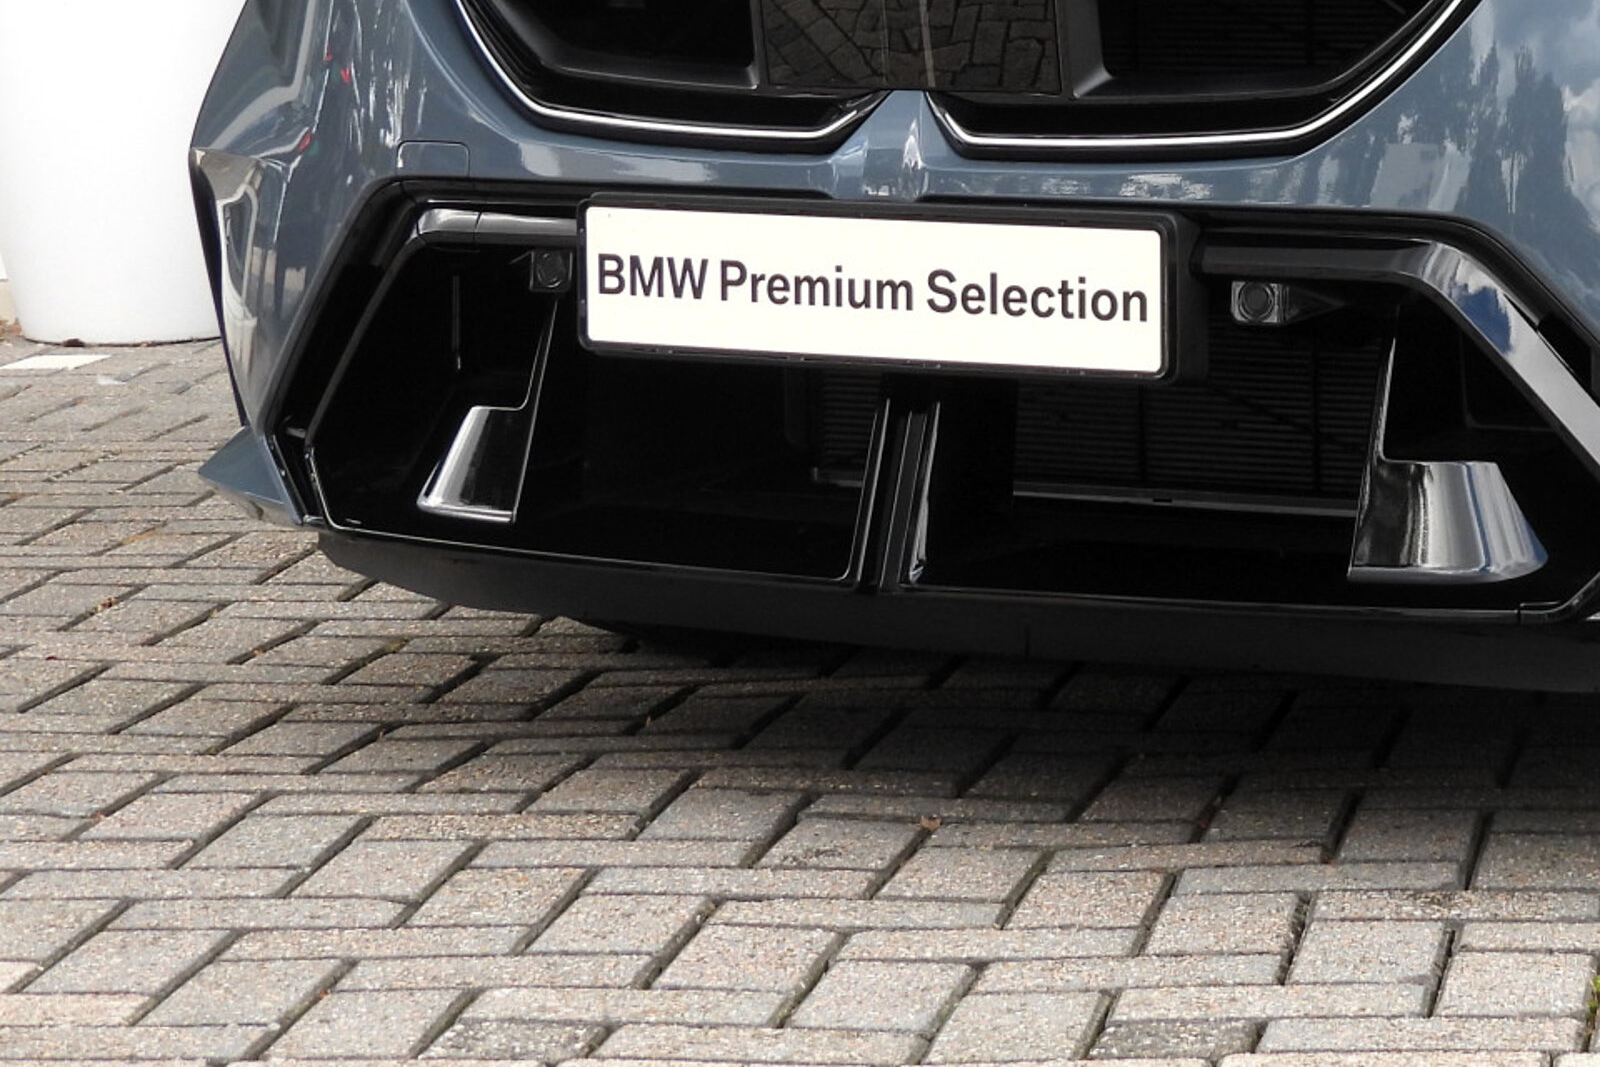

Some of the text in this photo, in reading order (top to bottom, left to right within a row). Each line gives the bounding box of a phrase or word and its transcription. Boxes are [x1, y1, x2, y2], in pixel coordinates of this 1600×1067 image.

[597, 253, 1148, 322] BMW Premium Selection
